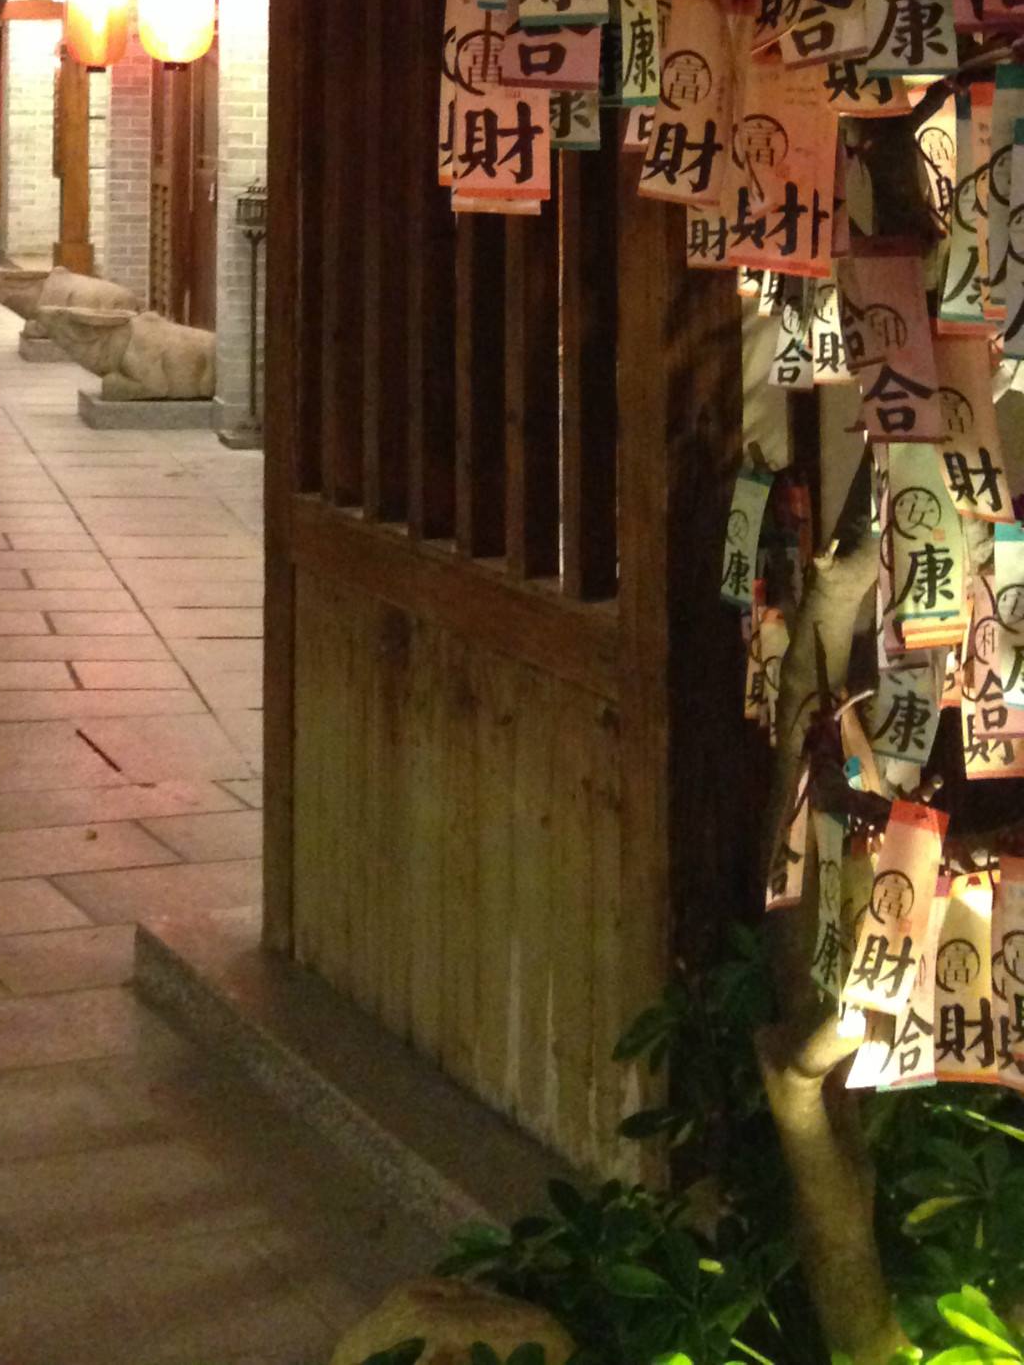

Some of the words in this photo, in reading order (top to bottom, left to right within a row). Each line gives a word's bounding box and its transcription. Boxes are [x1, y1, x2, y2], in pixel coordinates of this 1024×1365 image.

[623, 11, 657, 94] 康
[663, 54, 706, 108] 富
[457, 101, 543, 183] 財
[642, 118, 724, 194] 財
[689, 216, 728, 261] 財
[774, 338, 813, 384] 合
[863, 364, 932, 433] 合
[943, 446, 1003, 513] 財
[898, 544, 955, 609] 康
[877, 690, 934, 753] 康
[978, 669, 1009, 728] 合
[874, 873, 909, 920] 富
[855, 935, 916, 999] 財
[940, 942, 975, 990] 富
[936, 997, 995, 1068] 財
